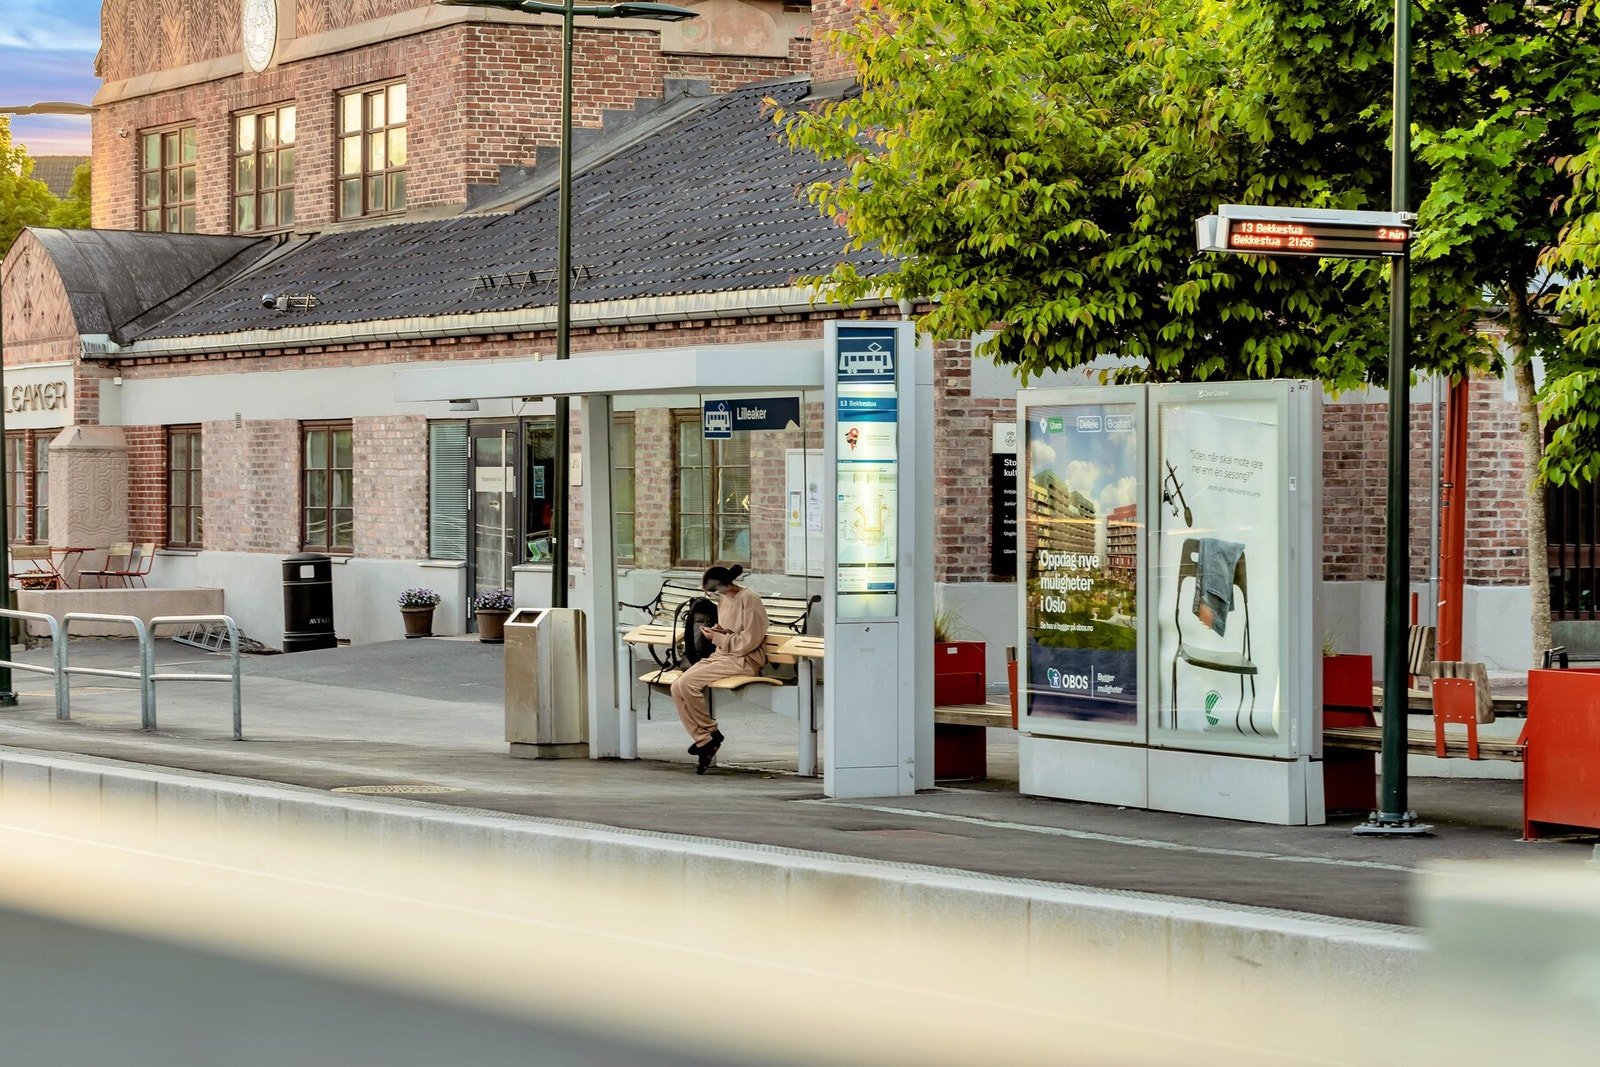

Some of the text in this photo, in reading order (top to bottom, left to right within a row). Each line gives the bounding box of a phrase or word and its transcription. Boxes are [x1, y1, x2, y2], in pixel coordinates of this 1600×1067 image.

[1241, 222, 1405, 240] 13 Bekkestua 2 min
[1233, 234, 1314, 247] Bekkestua 21:56
[736, 406, 767, 420] Lilleaker
[1079, 419, 1100, 430] Deleie
[1040, 549, 1100, 571] Oppdag nye
[1040, 573, 1095, 594] muligheter
[1040, 595, 1067, 613] i Oslo
[1062, 674, 1089, 690] OBOS
